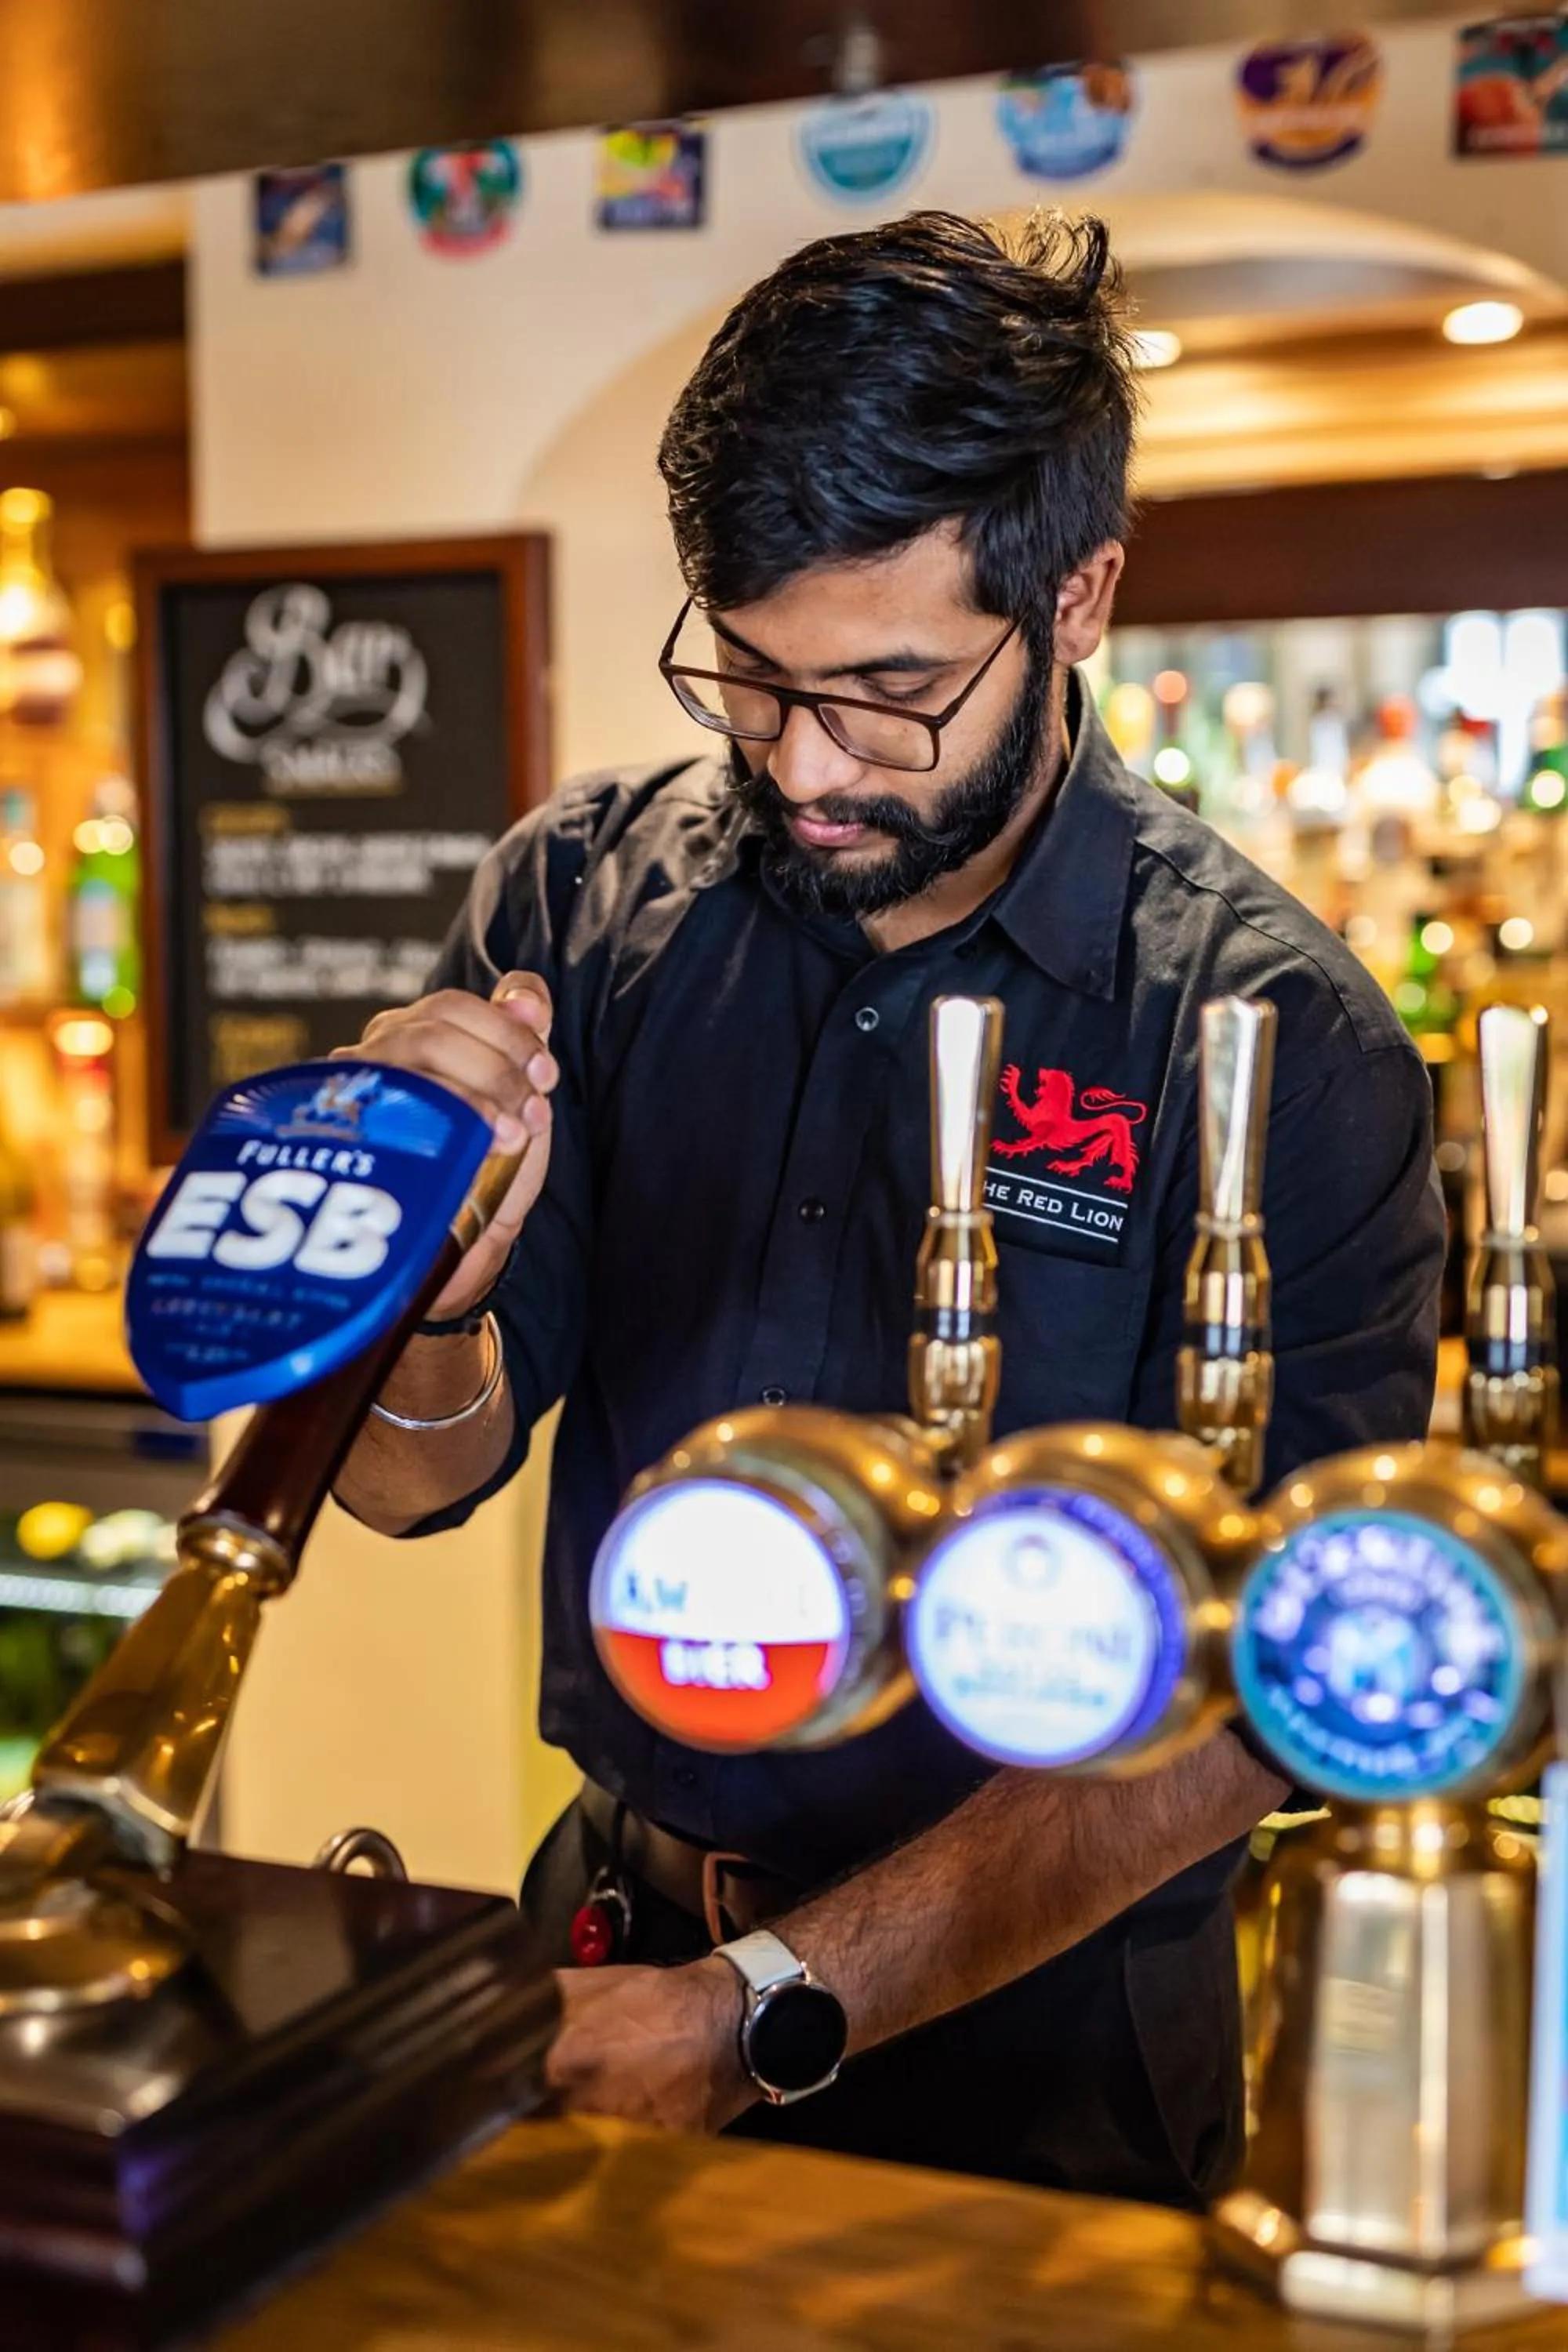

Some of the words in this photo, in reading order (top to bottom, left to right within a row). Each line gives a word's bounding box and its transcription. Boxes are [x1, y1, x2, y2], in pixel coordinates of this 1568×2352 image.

[236, 1139, 376, 1178] FULLER'S
[146, 1169, 403, 1280] ESB
[983, 1180, 1011, 1201] HE
[1016, 1189, 1063, 1214] RED
[1070, 1202, 1123, 1232] LION
